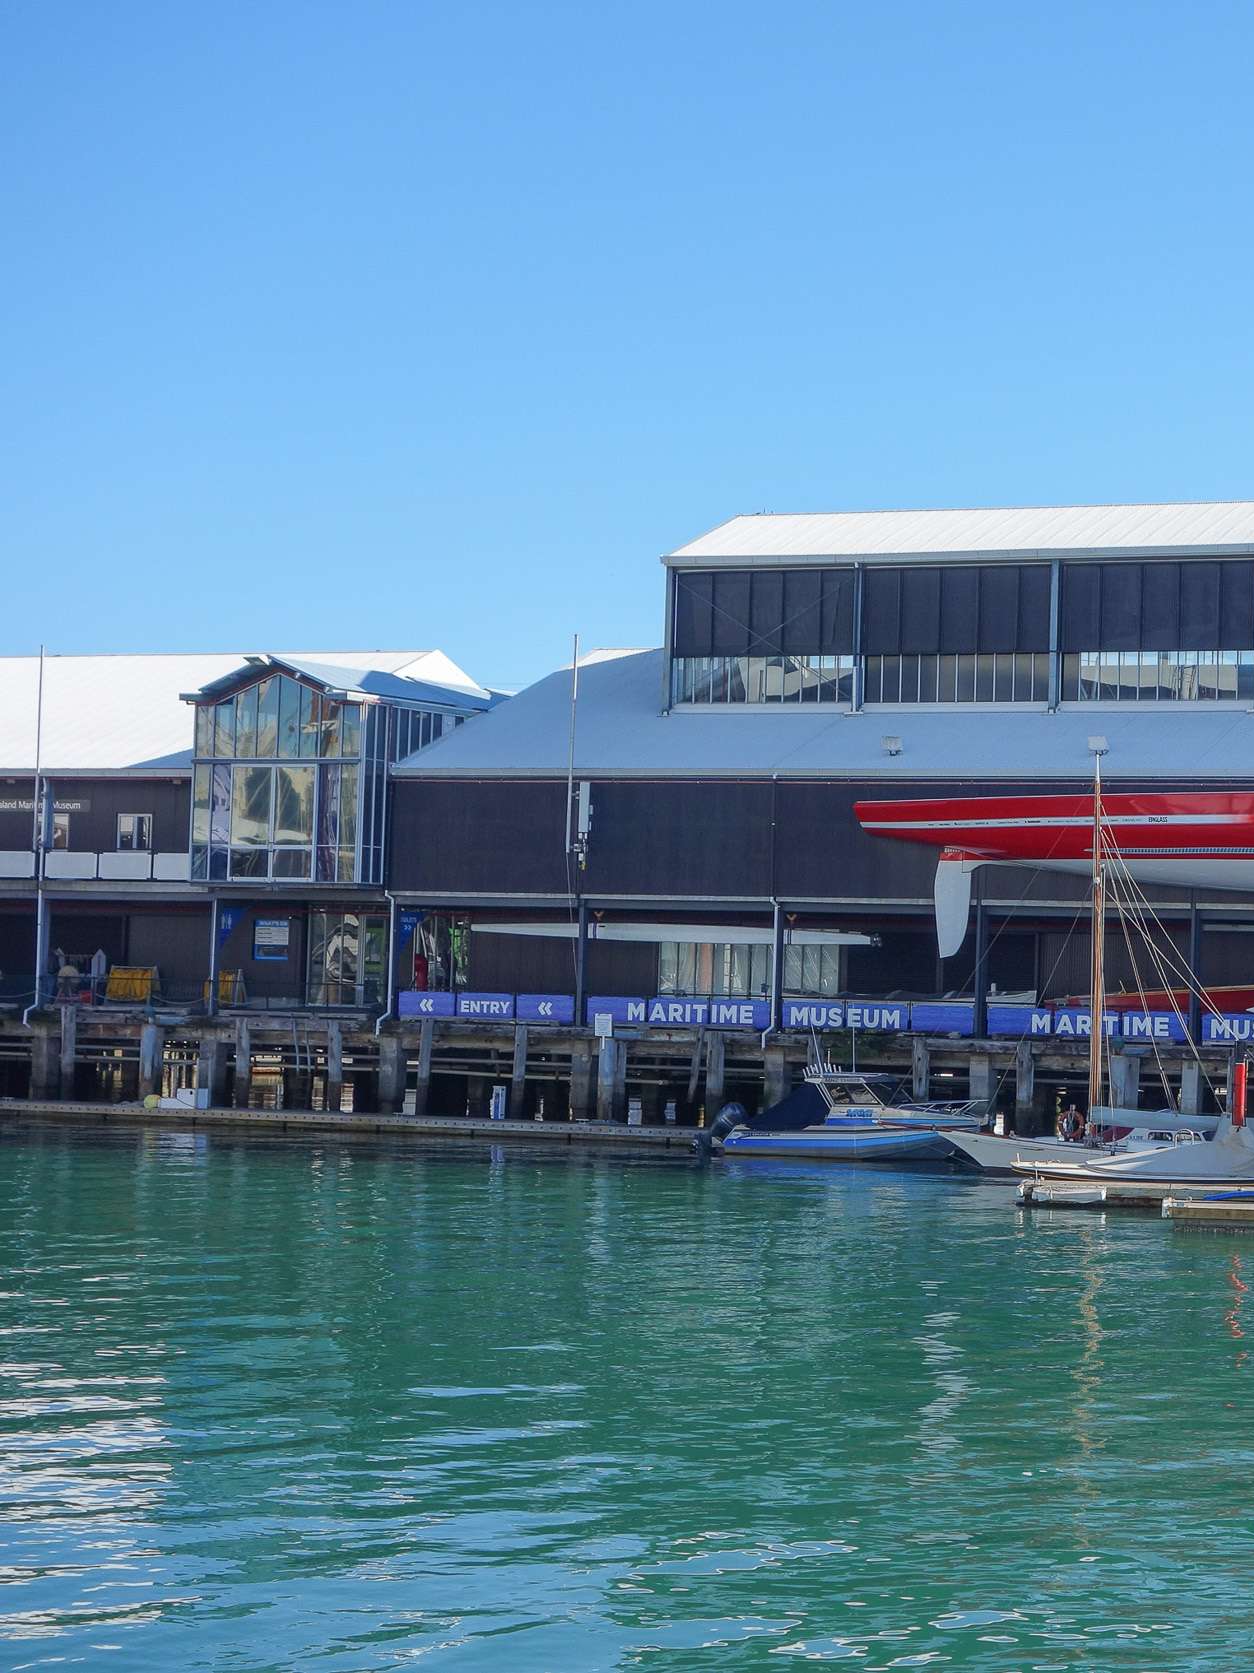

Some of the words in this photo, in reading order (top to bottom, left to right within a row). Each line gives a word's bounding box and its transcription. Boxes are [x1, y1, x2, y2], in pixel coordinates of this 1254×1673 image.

[460, 1000, 510, 1014] ENTRY
[627, 1002, 754, 1024] MARITIME
[790, 1006, 900, 1029] MUSEUM
[1031, 1014, 1169, 1037] MARTIME
